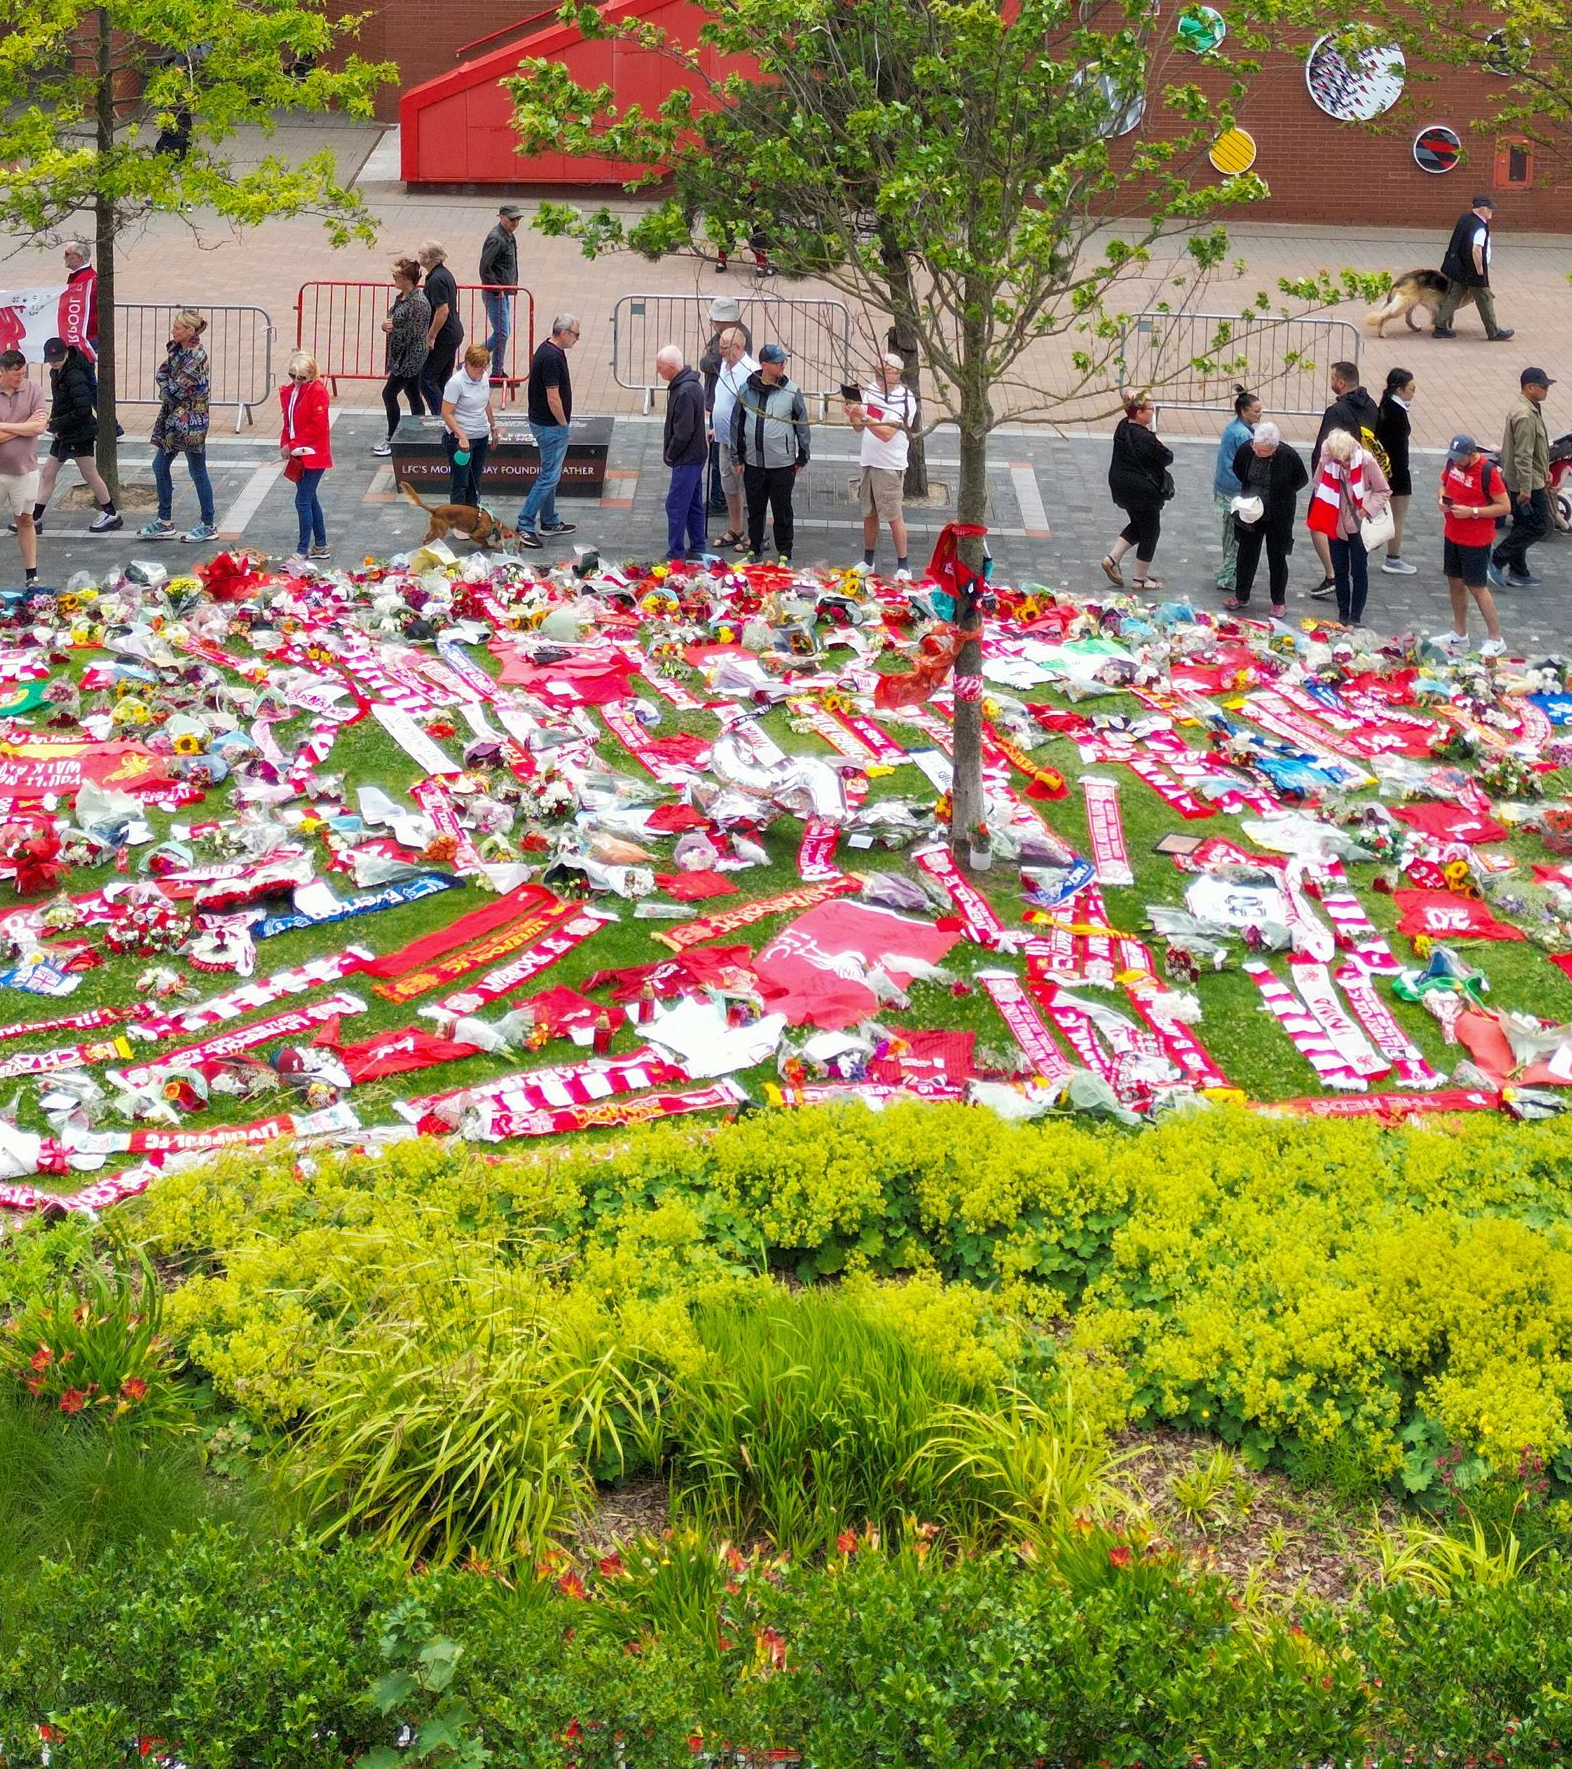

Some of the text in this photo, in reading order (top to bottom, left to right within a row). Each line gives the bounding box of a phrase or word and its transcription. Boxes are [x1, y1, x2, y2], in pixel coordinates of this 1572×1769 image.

[401, 465, 428, 475] LFC'S
[563, 466, 595, 476] ATHER
[470, 915, 552, 965] LIVERPOOL
[1311, 1097, 1382, 1114] REDS
[143, 1120, 279, 1149] LIVERPOOL FC
